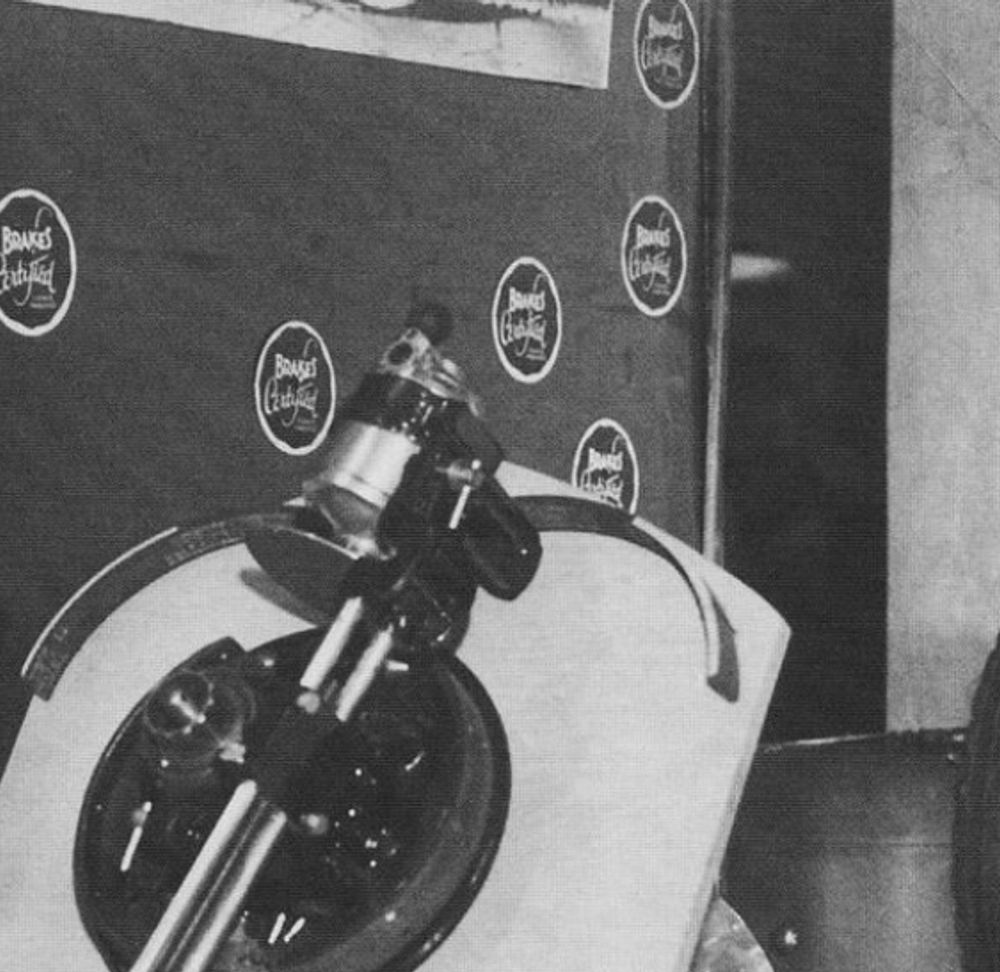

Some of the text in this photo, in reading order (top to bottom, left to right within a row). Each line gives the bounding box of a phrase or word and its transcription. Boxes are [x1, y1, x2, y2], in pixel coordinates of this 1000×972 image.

[636, 210, 671, 248] BRAKES
[509, 273, 546, 312] BRAKES
[275, 338, 318, 382] BRAKES
[264, 376, 319, 427] Certified
